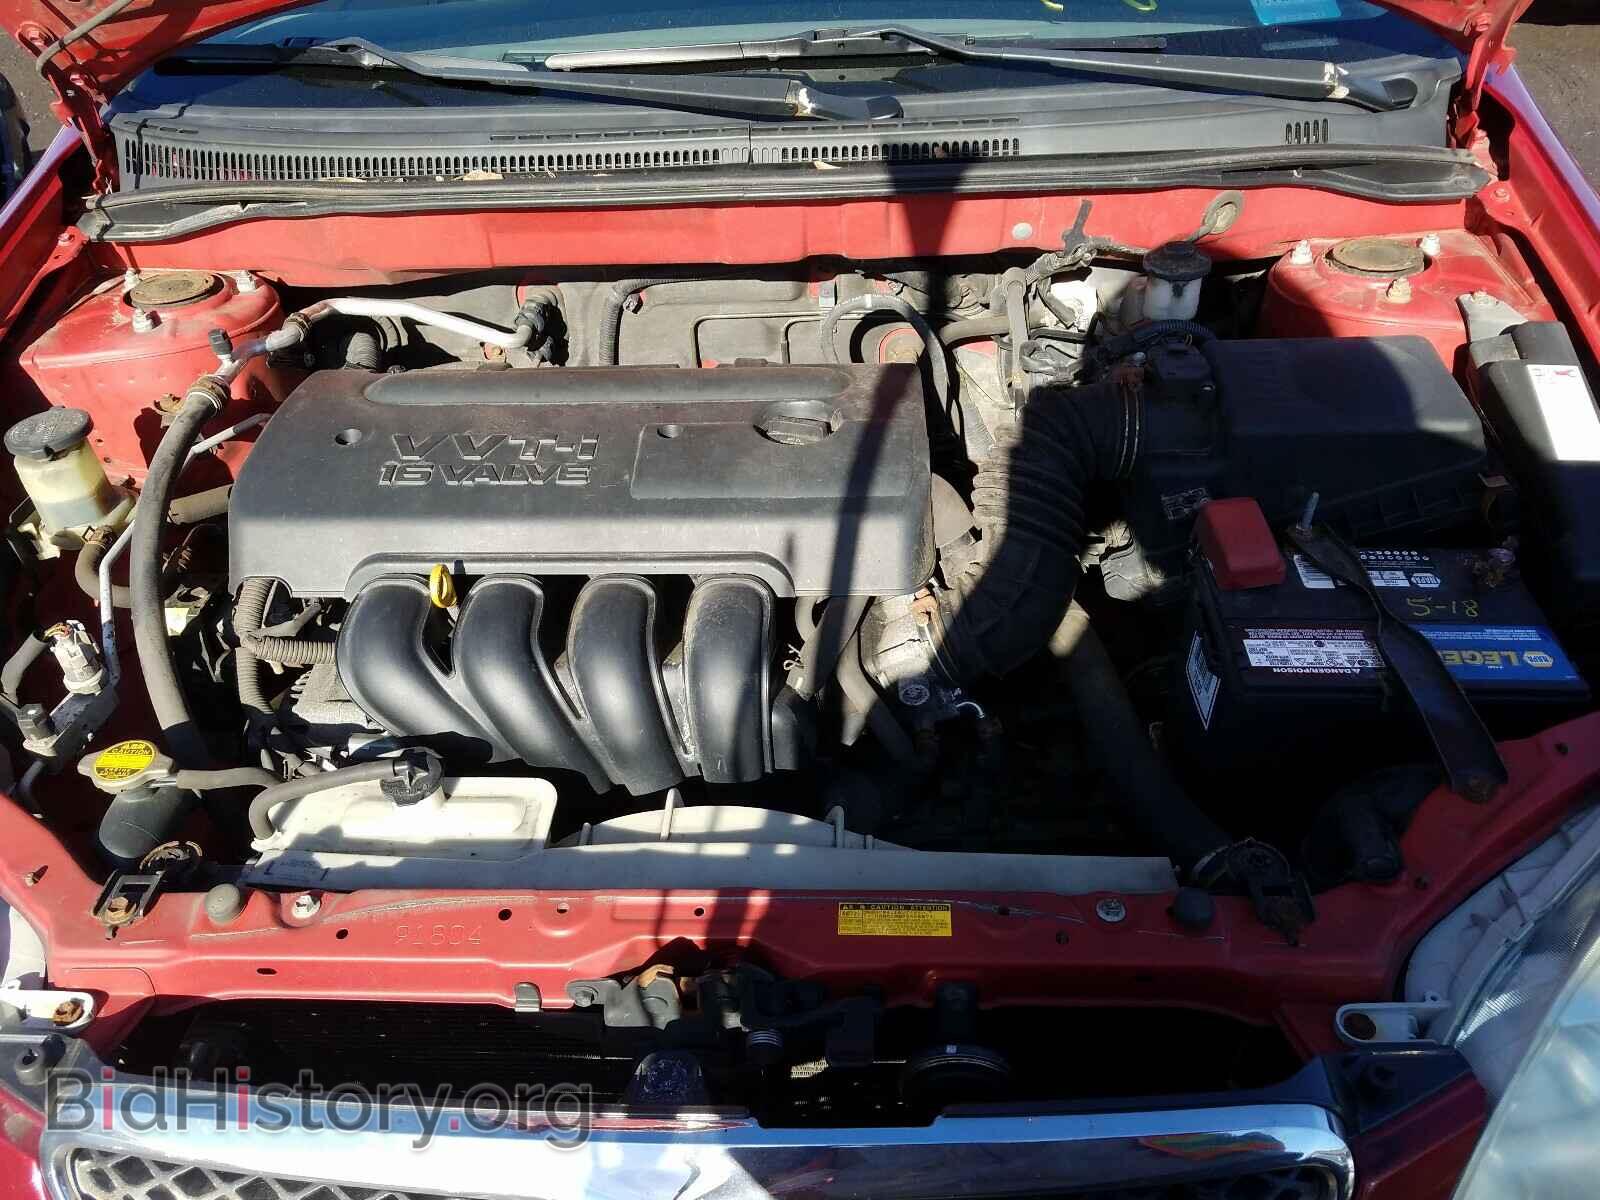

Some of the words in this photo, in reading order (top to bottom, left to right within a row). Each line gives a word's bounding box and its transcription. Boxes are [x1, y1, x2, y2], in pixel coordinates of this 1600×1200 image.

[379, 463, 434, 485] 16
[438, 463, 592, 485] VALVE
[1440, 650, 1520, 666] LEGE
